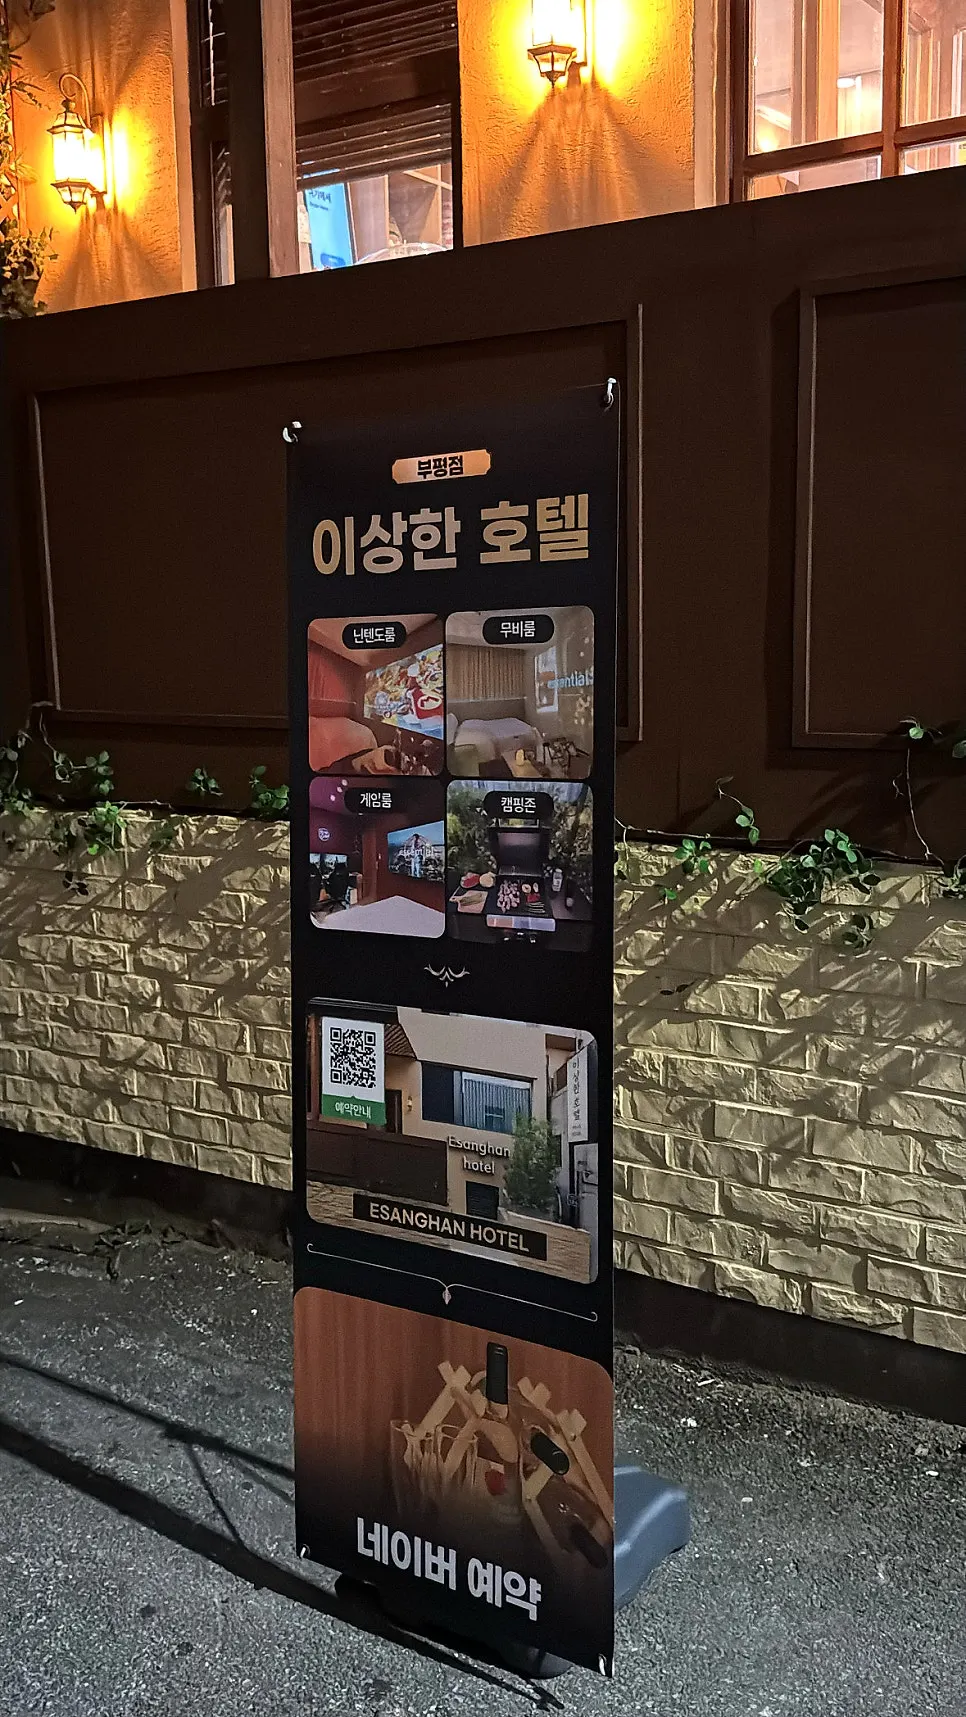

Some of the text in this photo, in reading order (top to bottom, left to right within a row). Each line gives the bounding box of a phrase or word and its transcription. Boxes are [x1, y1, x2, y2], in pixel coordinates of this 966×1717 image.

[416, 455, 464, 479] 부평점
[312, 493, 589, 576] 이상한 호텔
[353, 626, 396, 644] 닌텐도룸
[500, 620, 536, 638] 무비룸
[359, 792, 393, 809] 게임룸
[500, 796, 537, 814] 캠핑존
[334, 1101, 372, 1120] 예약안내
[448, 1135, 511, 1157] Esanghan
[463, 1156, 496, 1174] hotel
[369, 1202, 530, 1252] ESANGHAN HOTEL
[356, 1516, 542, 1622] 네이버 예약
